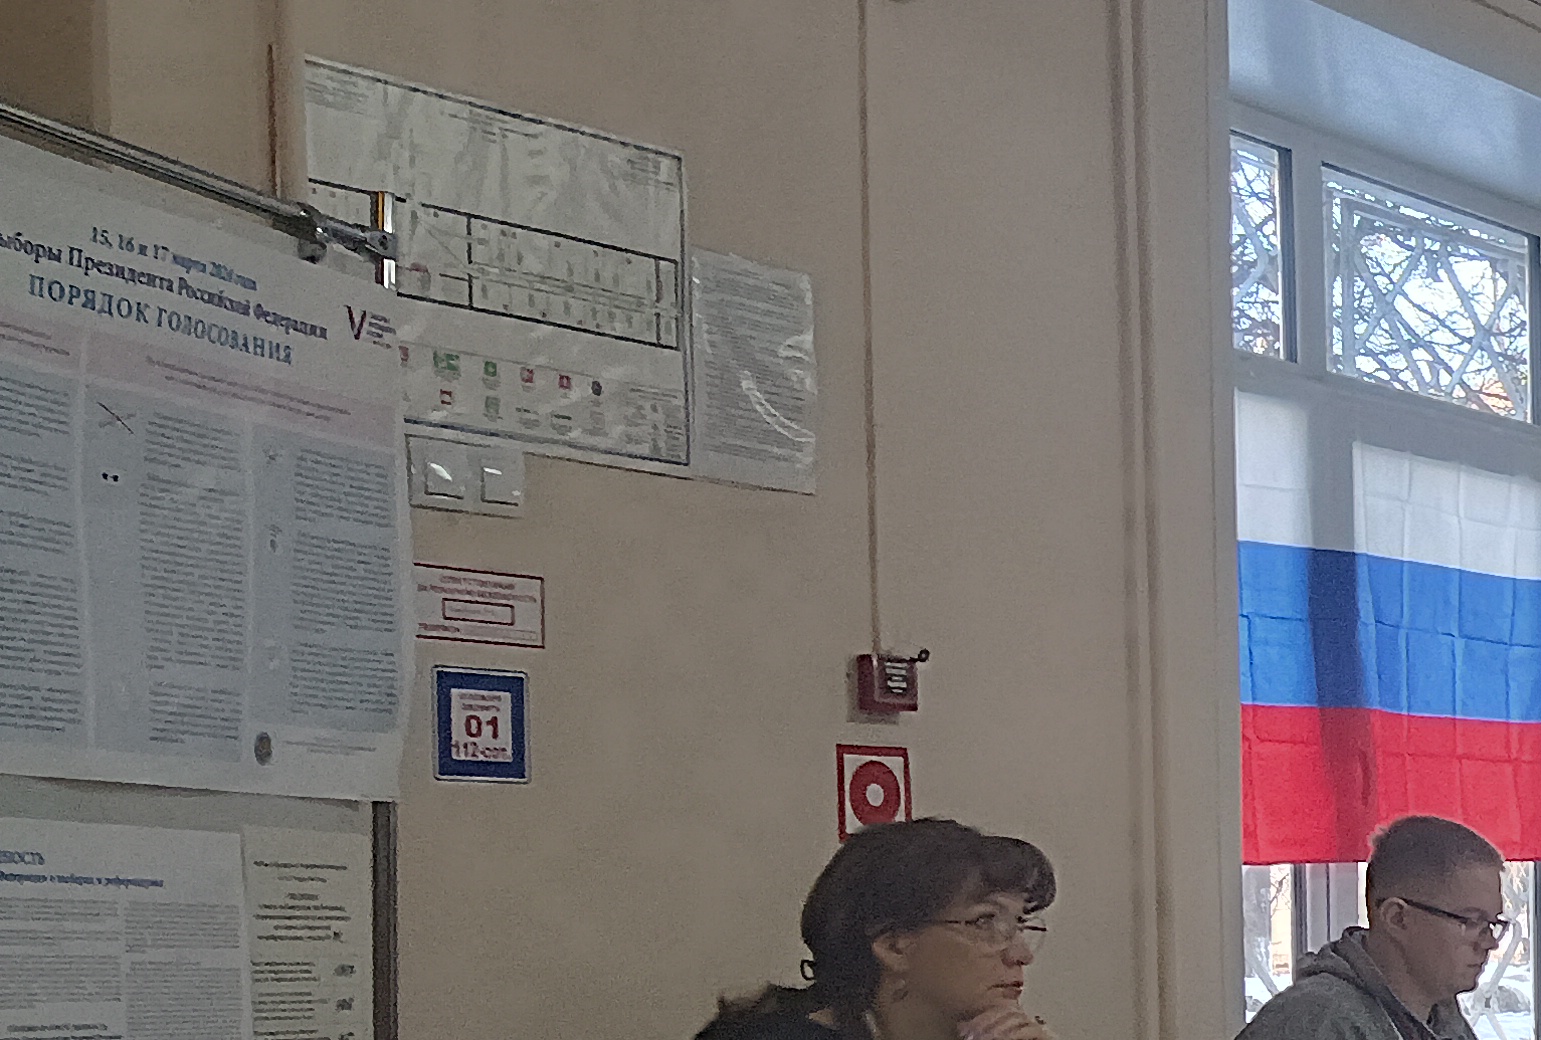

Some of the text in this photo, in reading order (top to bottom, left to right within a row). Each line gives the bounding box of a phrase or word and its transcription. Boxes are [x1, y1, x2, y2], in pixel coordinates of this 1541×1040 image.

[67, 245, 175, 294] Президента
[28, 273, 294, 365] ПОРЯДОК ГОЛОСОВАНИЯ
[464, 714, 500, 741] 01
